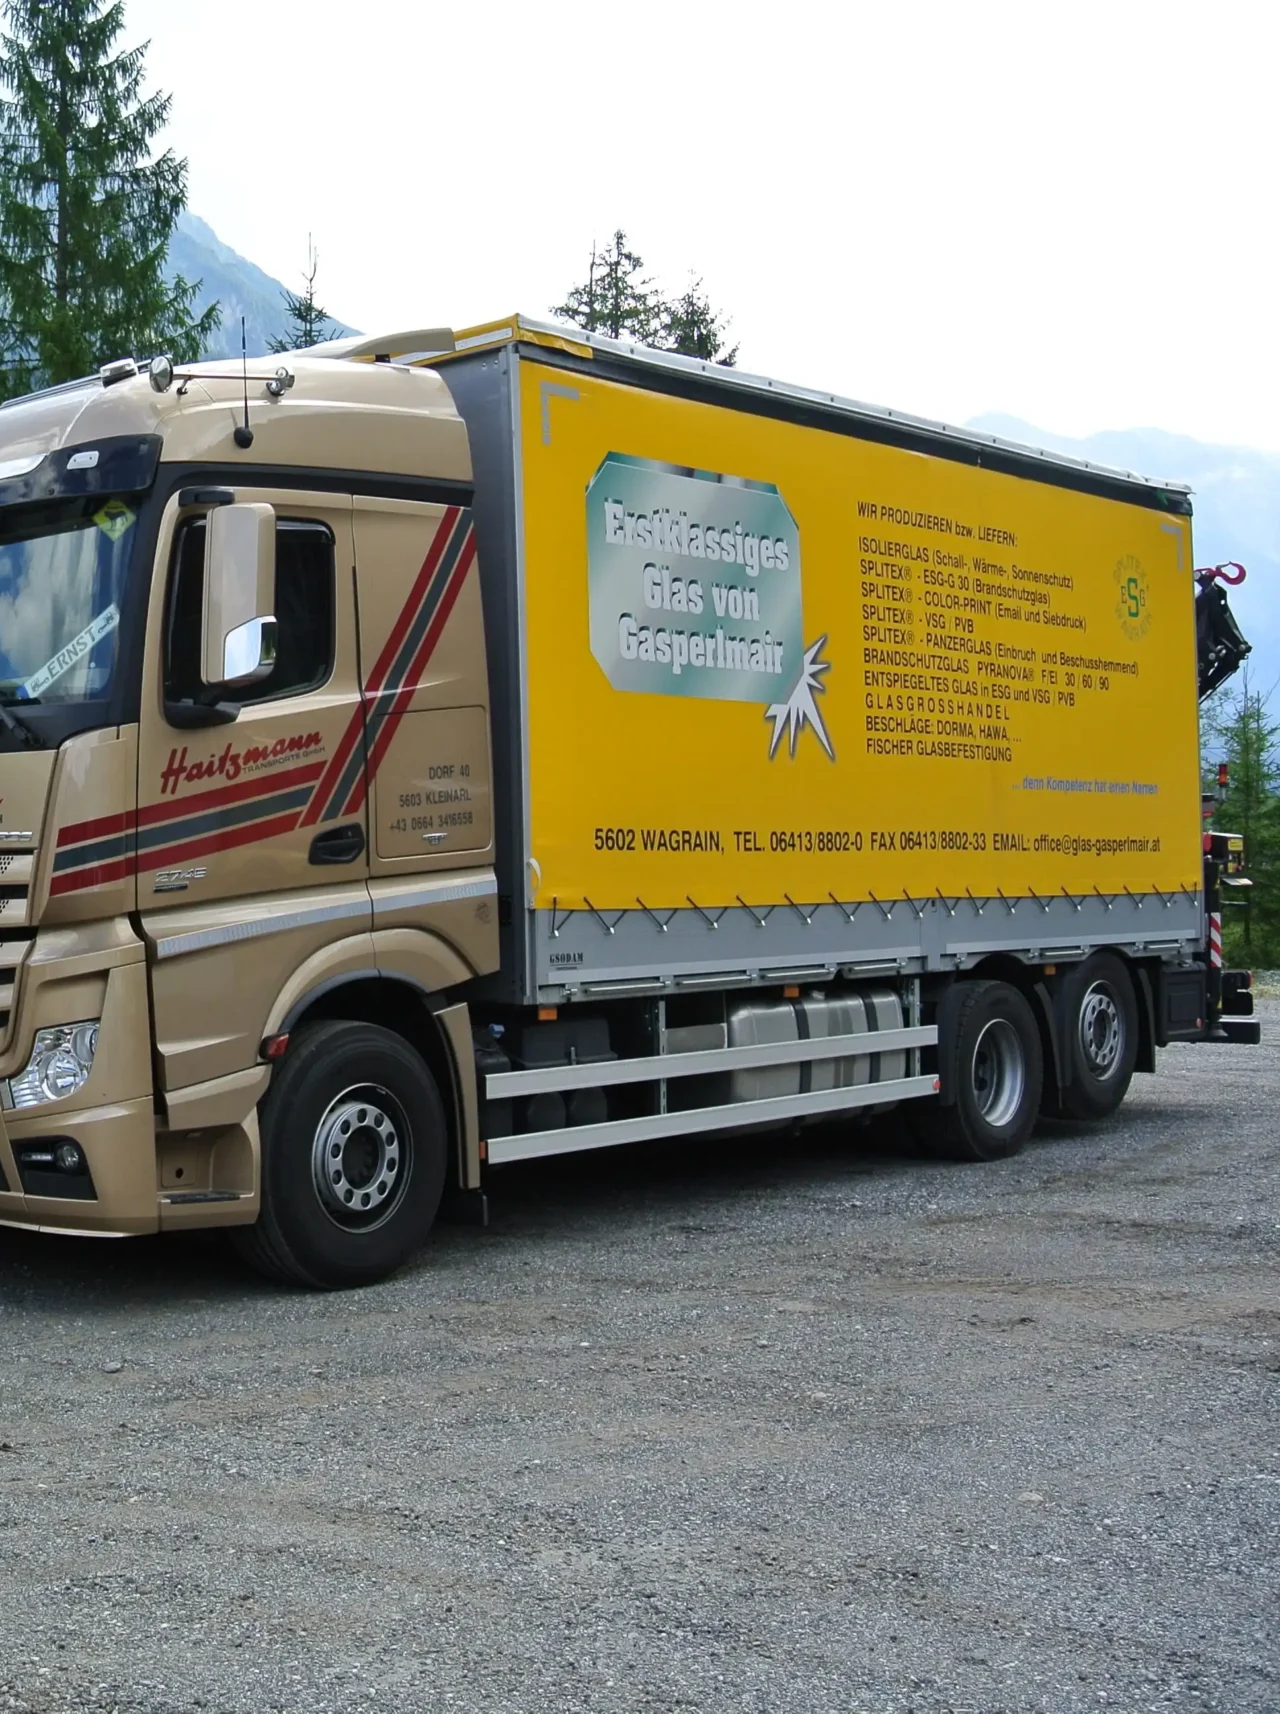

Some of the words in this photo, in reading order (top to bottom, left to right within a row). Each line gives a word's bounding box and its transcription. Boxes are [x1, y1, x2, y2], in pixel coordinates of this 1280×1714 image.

[604, 497, 789, 577] Erstklassiges
[857, 501, 877, 520] WIR
[880, 505, 952, 534] PRODUZIEREN
[955, 521, 975, 539] bzw.
[978, 525, 1018, 547] LIEFERN:
[858, 536, 929, 563] ISOLIERGLAS
[932, 550, 970, 574] (Schall-,
[972, 556, 1010, 580] Wärme-,
[1011, 564, 1074, 592] Sonnenschutz)
[860, 558, 912, 581] SPLITEX®
[923, 569, 955, 589] ESG-G
[958, 575, 970, 591] 30
[972, 578, 1050, 608] (Brandschutzglas)
[643, 562, 703, 615] Glas
[711, 581, 760, 621] von
[861, 581, 913, 604] SPLITEX®
[924, 590, 992, 616] COLOR-PRINT
[994, 600, 1021, 621] (Email
[1024, 608, 1040, 623] und
[1042, 610, 1087, 634] Siebdruck)
[862, 603, 914, 625] SPLITEX®
[925, 612, 946, 630] VSG
[955, 617, 974, 633] PVB
[47, 626, 97, 678] ERNST
[618, 611, 783, 675] Gasperlmair
[863, 625, 915, 646] SPLITEX®
[926, 632, 992, 656] PANZERGLAS
[994, 642, 1036, 662] (Einbruch
[1041, 651, 1057, 665] und
[1060, 651, 1139, 679] Beschusshemmend)
[863, 647, 970, 674] BRANDSCHUTZGLAS
[977, 660, 1034, 682] PYRANOVA®
[1065, 672, 1076, 687] 30
[1082, 674, 1093, 689] 60
[1099, 676, 1110, 691] 90
[864, 670, 949, 693] ENTSPIEGELTES
[951, 679, 978, 696] GLAS
[980, 682, 989, 697] in
[991, 683, 1011, 700] ESG
[1013, 688, 1030, 702] und
[1032, 689, 1051, 704] VSG
[1057, 691, 1076, 707] PVB
[866, 714, 934, 735] BESCHLÄGE:
[936, 719, 977, 740] DORMA,
[979, 725, 1011, 743] HAWA,
[160, 731, 323, 795] Haitzmann
[242, 752, 301, 774] TRANSPORTE
[866, 738, 913, 755] FISCHER
[916, 740, 1012, 762] GLASBEFESTIGUNG
[428, 765, 455, 780] DORF
[459, 764, 470, 778] 40
[1023, 775, 1044, 791] denn
[1046, 776, 1092, 794] Kompetenz
[1094, 778, 1107, 793] hat
[399, 793, 422, 808] 5603
[425, 788, 472, 805] KLEINARL
[389, 818, 407, 832] +43
[594, 828, 636, 851] 5602
[641, 829, 725, 855] WAGRAIN,
[733, 830, 766, 853] TEL.
[769, 830, 863, 855] 06413/8802-0
[870, 832, 896, 851] FAX
[899, 831, 987, 852] 06413/8802-33
[992, 833, 1031, 852] EMAIL:
[1033, 834, 1161, 856] office@glas-gasperlmair.at
[549, 952, 584, 964] GSODAM
